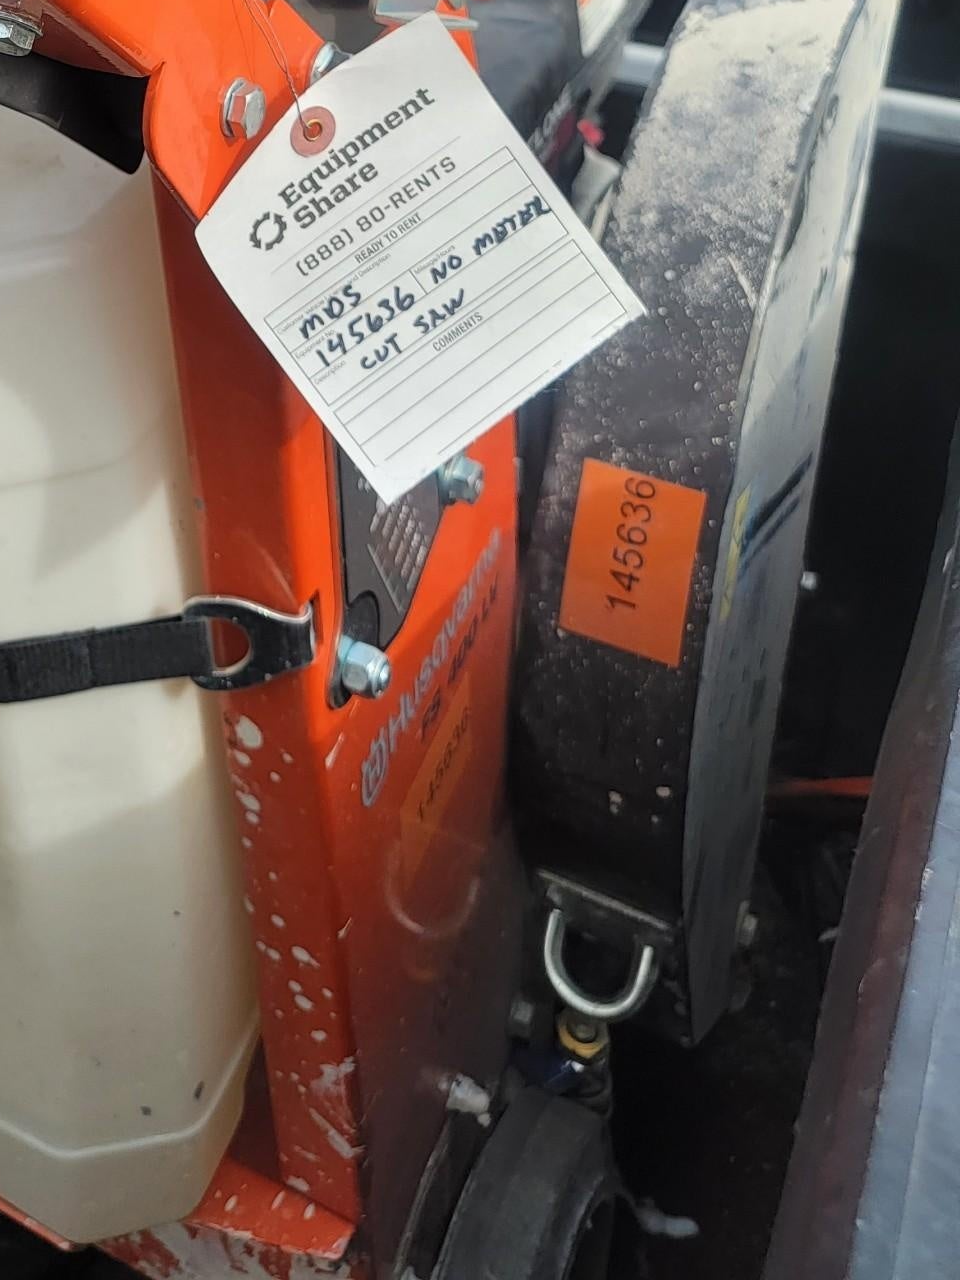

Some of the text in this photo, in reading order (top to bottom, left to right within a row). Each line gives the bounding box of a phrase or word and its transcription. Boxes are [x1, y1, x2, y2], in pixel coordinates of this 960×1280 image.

[278, 88, 435, 208] Equipment
[293, 162, 379, 229] Share
[296, 156, 456, 276] (888) 80-RENTS
[355, 211, 422, 263] READY TO RENT
[358, 252, 392, 280] Description
[430, 255, 462, 284] NO
[316, 286, 415, 367] 145636
[360, 288, 464, 369] CUT SAW
[432, 312, 483, 352] COMMENTS
[605, 476, 656, 610] 145636
